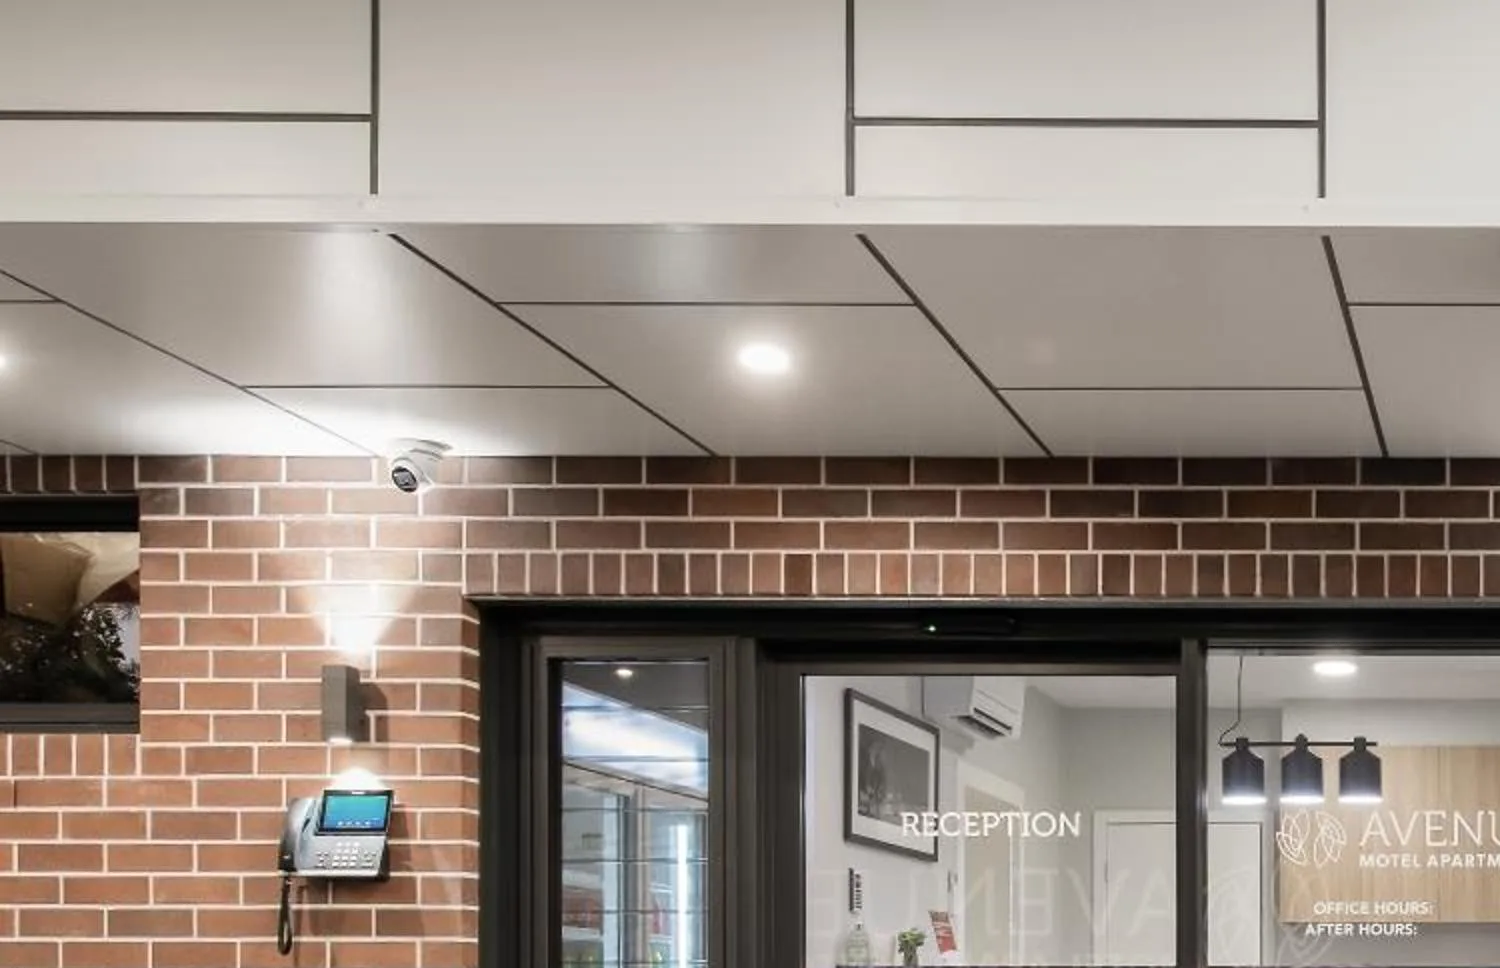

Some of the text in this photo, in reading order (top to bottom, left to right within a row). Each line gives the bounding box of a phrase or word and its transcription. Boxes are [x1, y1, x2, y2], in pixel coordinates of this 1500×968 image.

[900, 811, 1082, 838] RECEPTION
[1358, 853, 1422, 868] MOTEL
[1313, 900, 1370, 915] OFFICE
[1305, 923, 1418, 937] AFTER HOURS:
